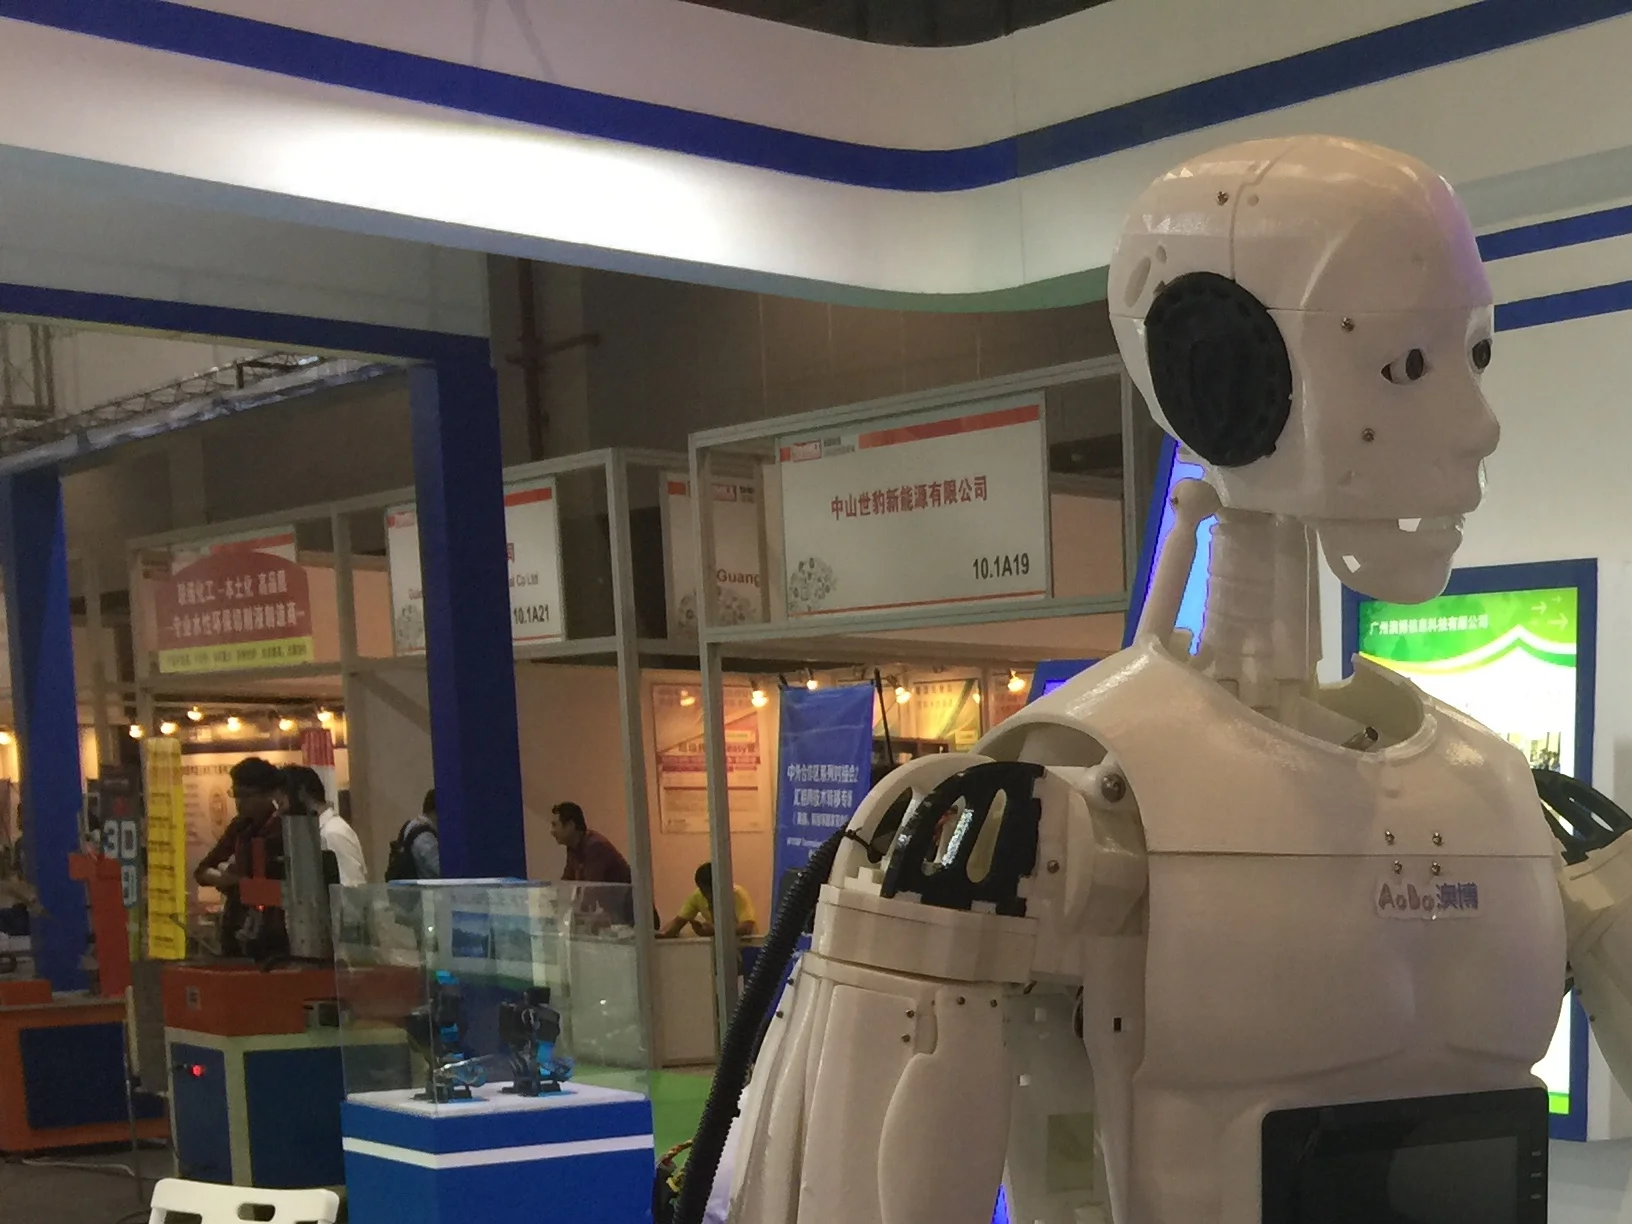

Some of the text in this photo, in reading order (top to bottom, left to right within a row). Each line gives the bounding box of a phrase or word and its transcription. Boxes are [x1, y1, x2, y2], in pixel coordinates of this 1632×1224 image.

[830, 475, 988, 520] 中山世豹新能源有限公司
[972, 552, 1030, 579] 10.1A19
[513, 604, 550, 625] 10.1A21
